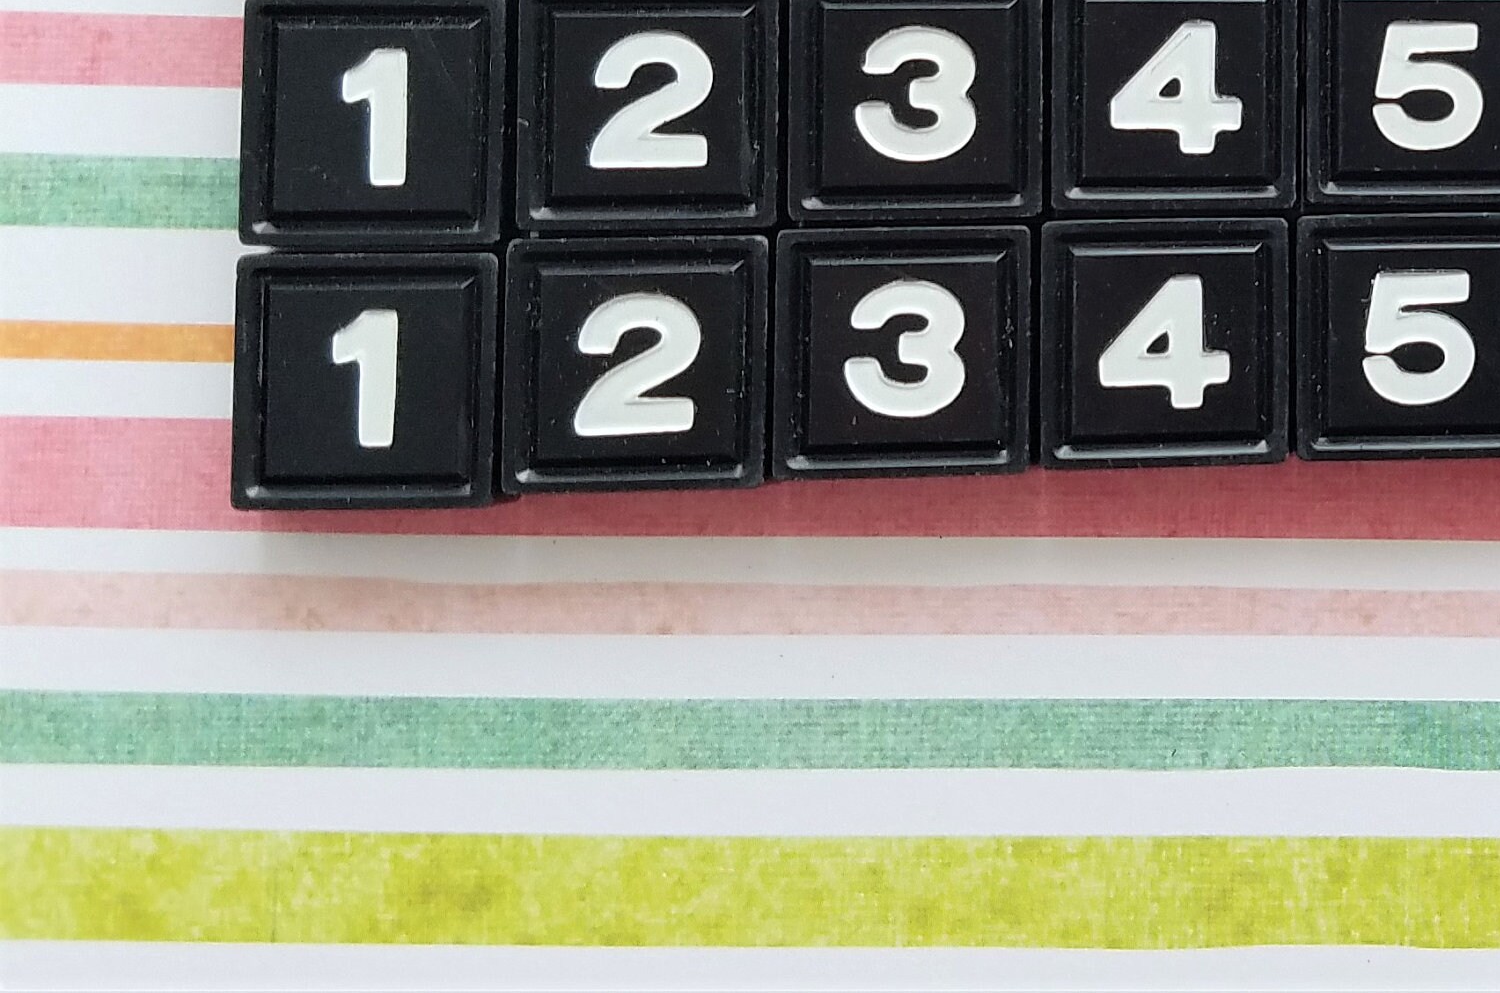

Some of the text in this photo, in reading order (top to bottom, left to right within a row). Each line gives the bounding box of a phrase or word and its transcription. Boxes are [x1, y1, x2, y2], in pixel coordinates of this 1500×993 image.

[341, 47, 408, 187] 1
[589, 32, 714, 169] 2
[854, 25, 977, 162] 3
[1109, 19, 1243, 155] 4
[1372, 22, 1484, 151] 5
[331, 309, 399, 448] 1
[573, 292, 702, 437] 2
[843, 280, 966, 418] 3
[1098, 276, 1231, 409] 4
[1362, 270, 1476, 406] 5
